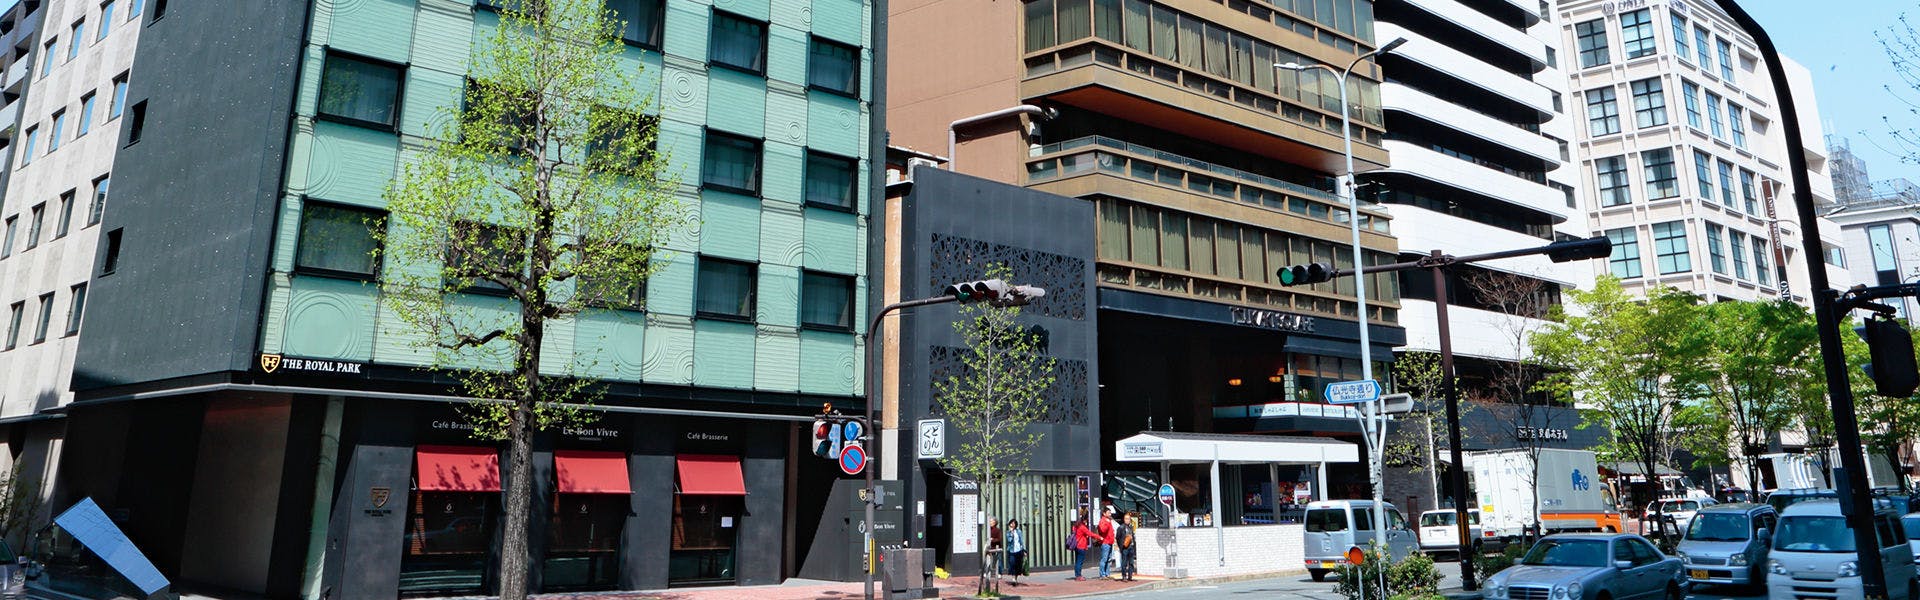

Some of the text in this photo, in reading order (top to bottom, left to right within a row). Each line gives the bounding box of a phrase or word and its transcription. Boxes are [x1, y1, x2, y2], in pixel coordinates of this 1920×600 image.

[282, 358, 361, 373] THE ROYAL PARK
[596, 428, 618, 437] Vivre
